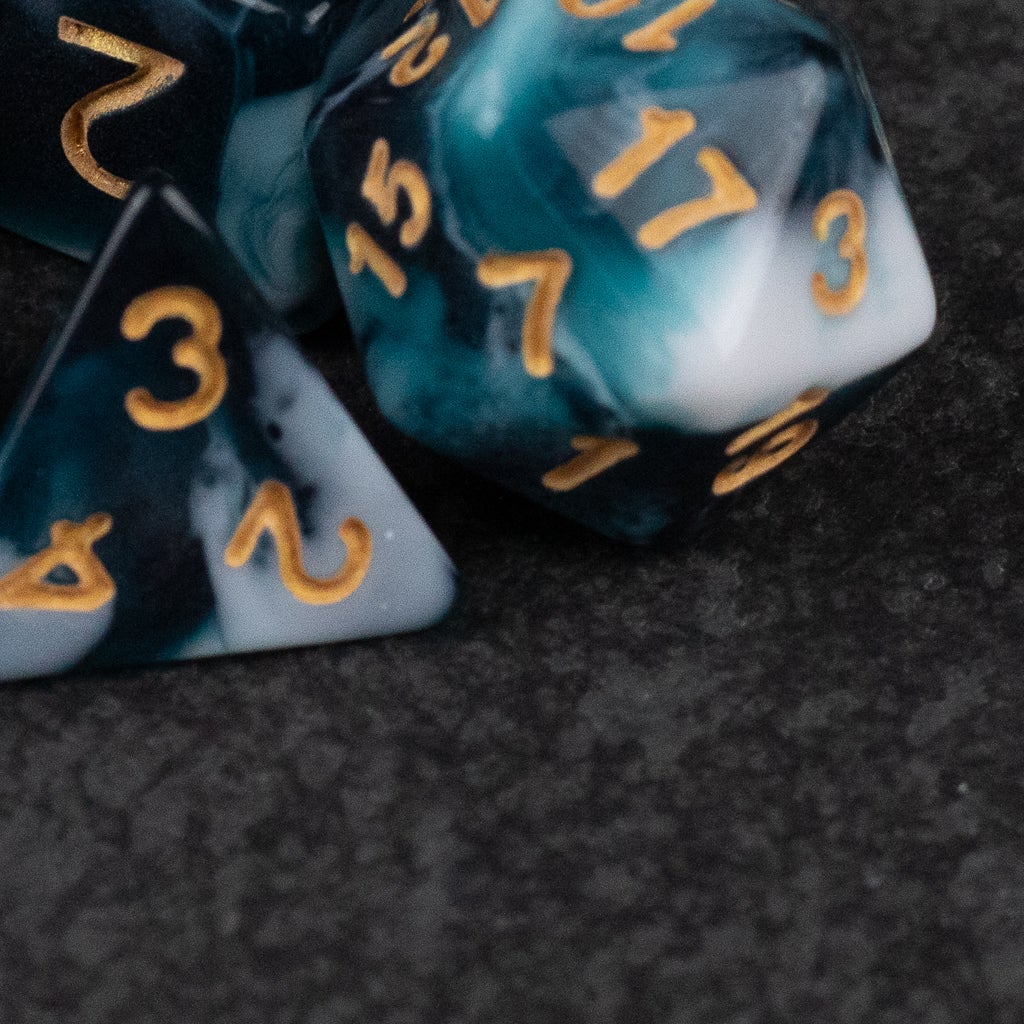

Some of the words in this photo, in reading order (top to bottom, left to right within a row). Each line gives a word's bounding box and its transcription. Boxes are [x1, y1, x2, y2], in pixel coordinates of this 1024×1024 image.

[345, 137, 433, 298] 15
[593, 106, 758, 249] 17
[476, 248, 573, 378] 7
[810, 188, 869, 316] 3
[120, 286, 229, 432] 3
[224, 480, 374, 605] 2
